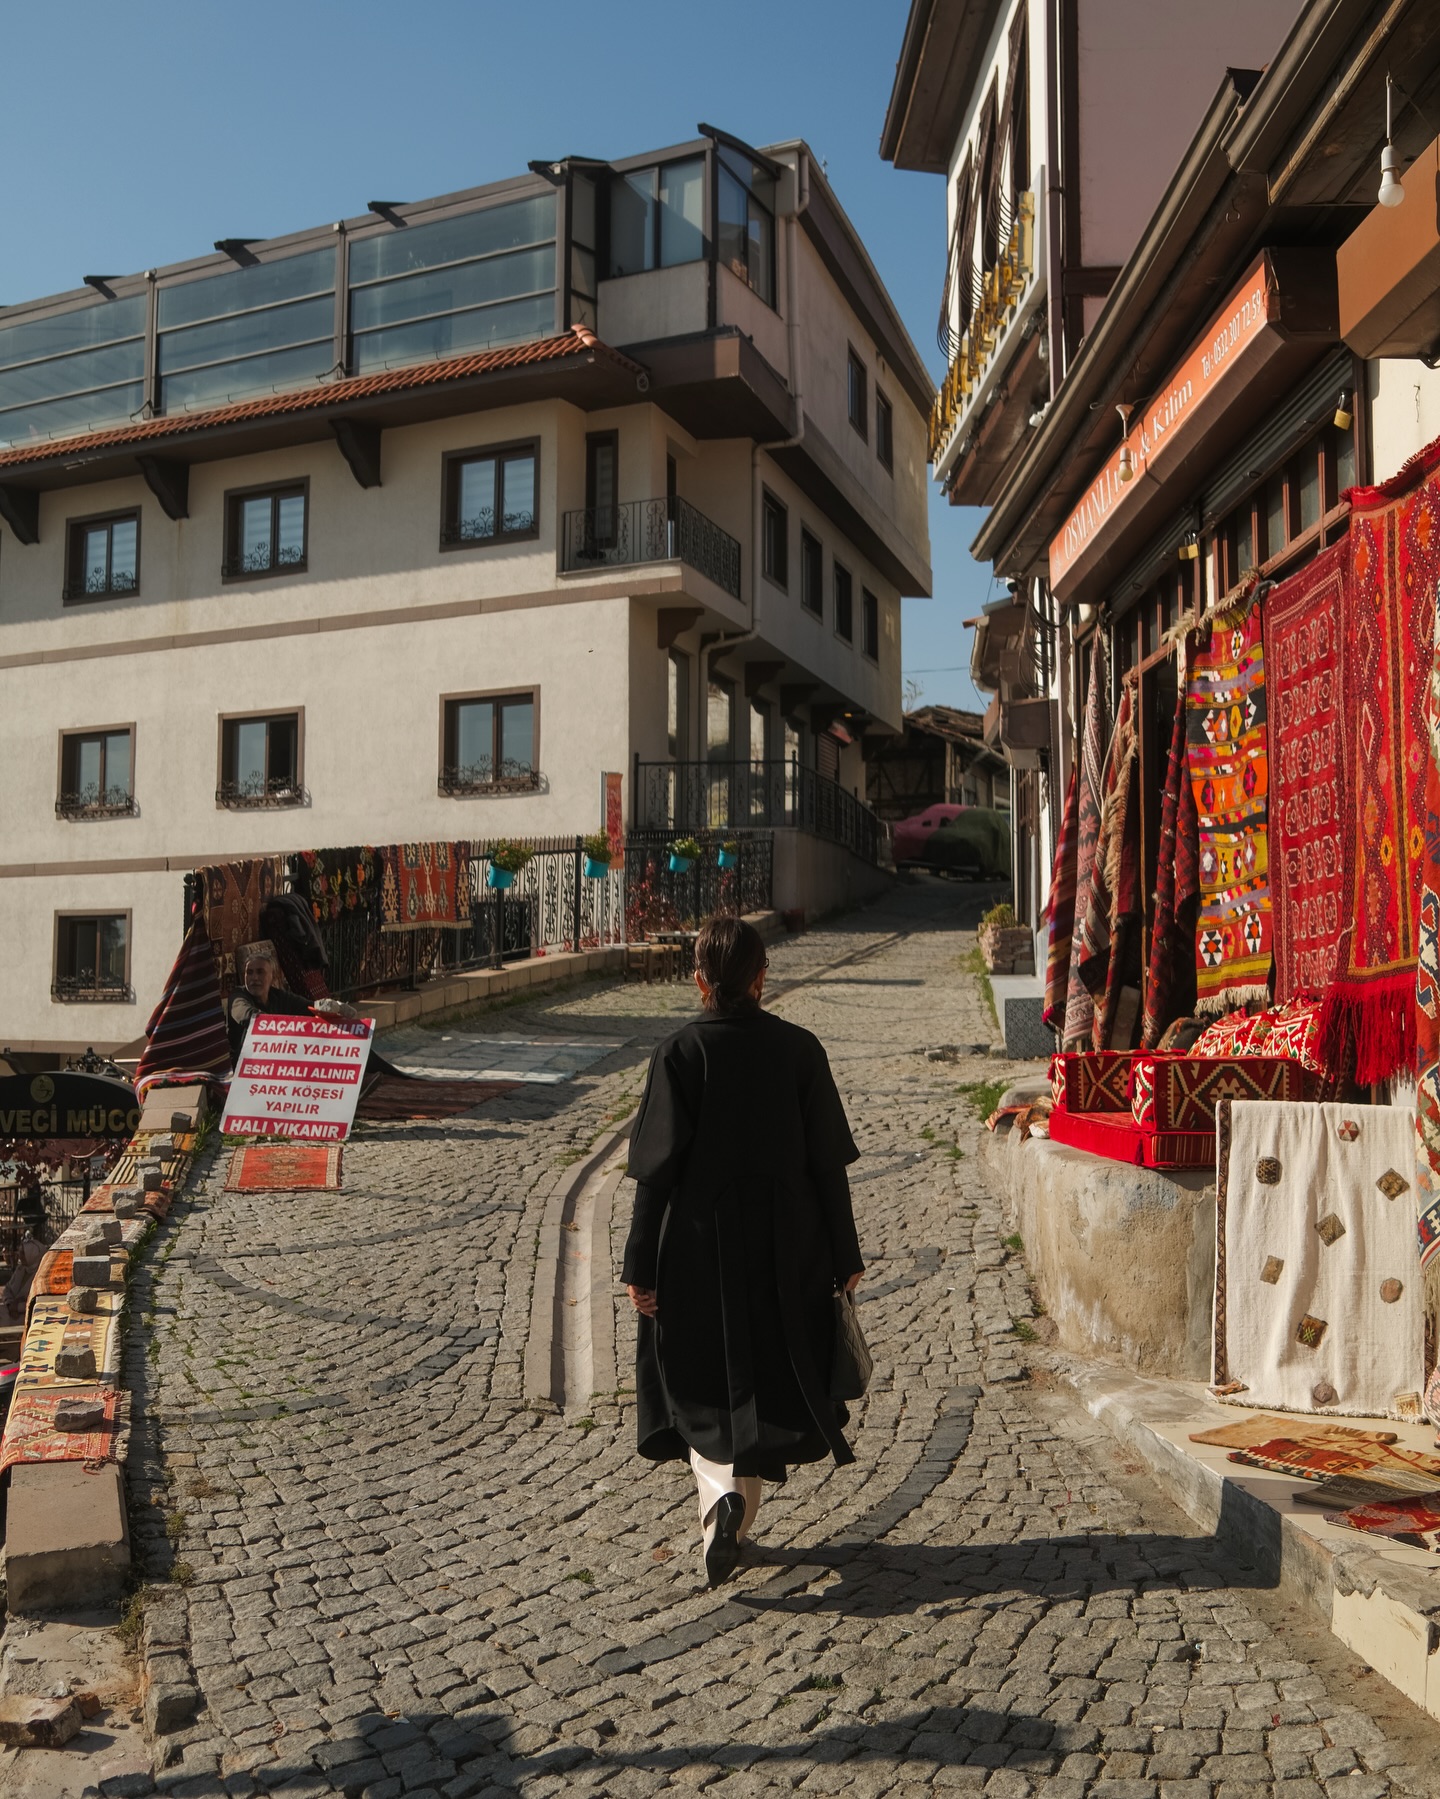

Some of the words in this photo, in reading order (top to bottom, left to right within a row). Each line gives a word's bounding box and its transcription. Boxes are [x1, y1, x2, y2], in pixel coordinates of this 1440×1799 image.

[1214, 328, 1228, 364] 0532
[1229, 312, 1240, 346] 307
[1242, 301, 1250, 330] 72
[1252, 288, 1261, 320] 59
[1064, 469, 1113, 560] OSMANLI
[1139, 431, 1152, 460] &
[1152, 378, 1194, 442] Kilim
[258, 1020, 306, 1034] SAÇAK
[311, 1022, 366, 1035] YAPILIR
[252, 1040, 298, 1054] TAMİR
[303, 1044, 361, 1058] YAPILIR
[243, 1063, 275, 1076] ESKİ
[277, 1066, 308, 1077] HALI
[311, 1068, 356, 1080] ALINIR
[249, 1084, 288, 1096] ŞARK
[291, 1085, 344, 1100] KÖŞESİ
[266, 1101, 320, 1114] YAPILIR
[229, 1119, 267, 1133] HALI
[273, 1121, 339, 1138] YIKANIR
